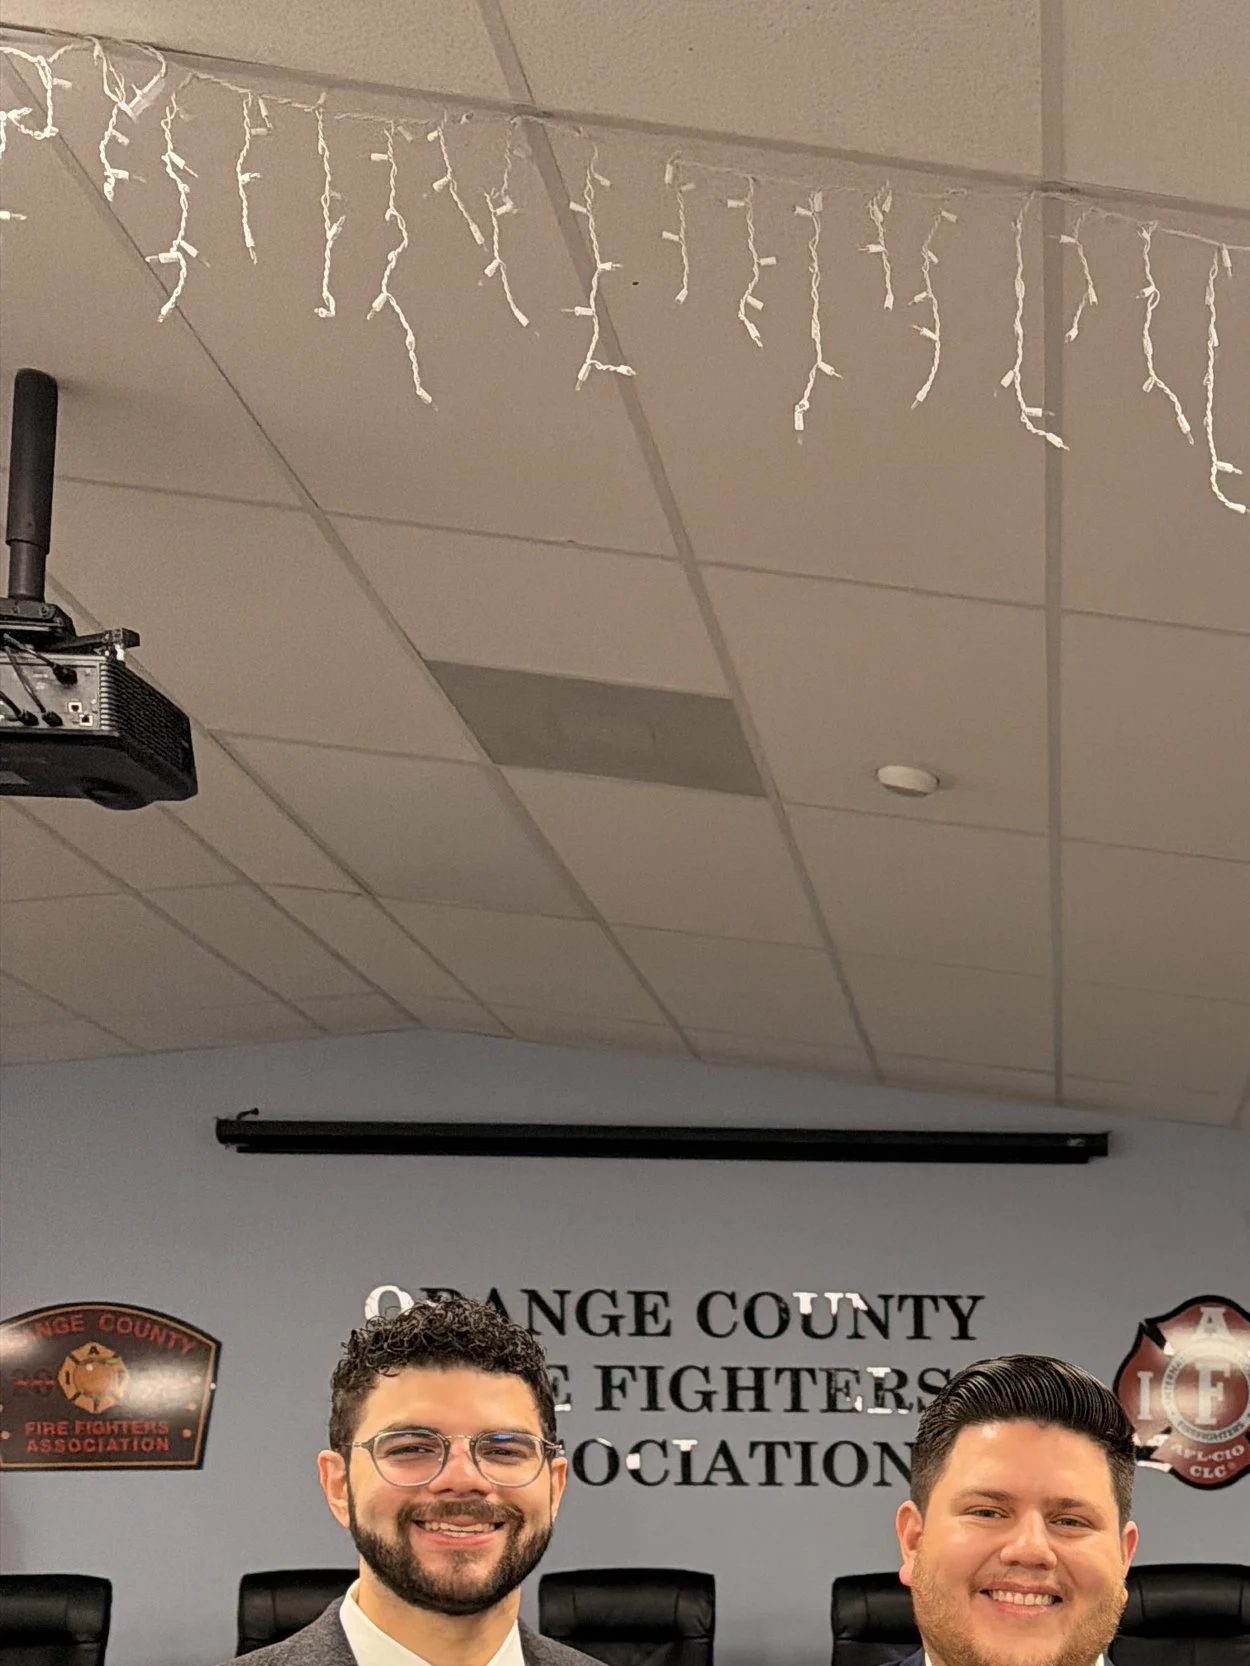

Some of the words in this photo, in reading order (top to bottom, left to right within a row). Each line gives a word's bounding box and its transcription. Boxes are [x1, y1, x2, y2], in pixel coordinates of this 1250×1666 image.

[99, 1314, 197, 1355] COUNTY
[697, 1291, 985, 1341] COUNTY
[594, 1364, 950, 1414] FIGHTERS
[1137, 1371, 1153, 1420] I
[1194, 1361, 1231, 1425] F
[25, 1421, 68, 1436] FIRE
[75, 1419, 169, 1435] FIGHTERS
[27, 1437, 169, 1453] ASSOCIATION
[1189, 1464, 1227, 1478] CLC
